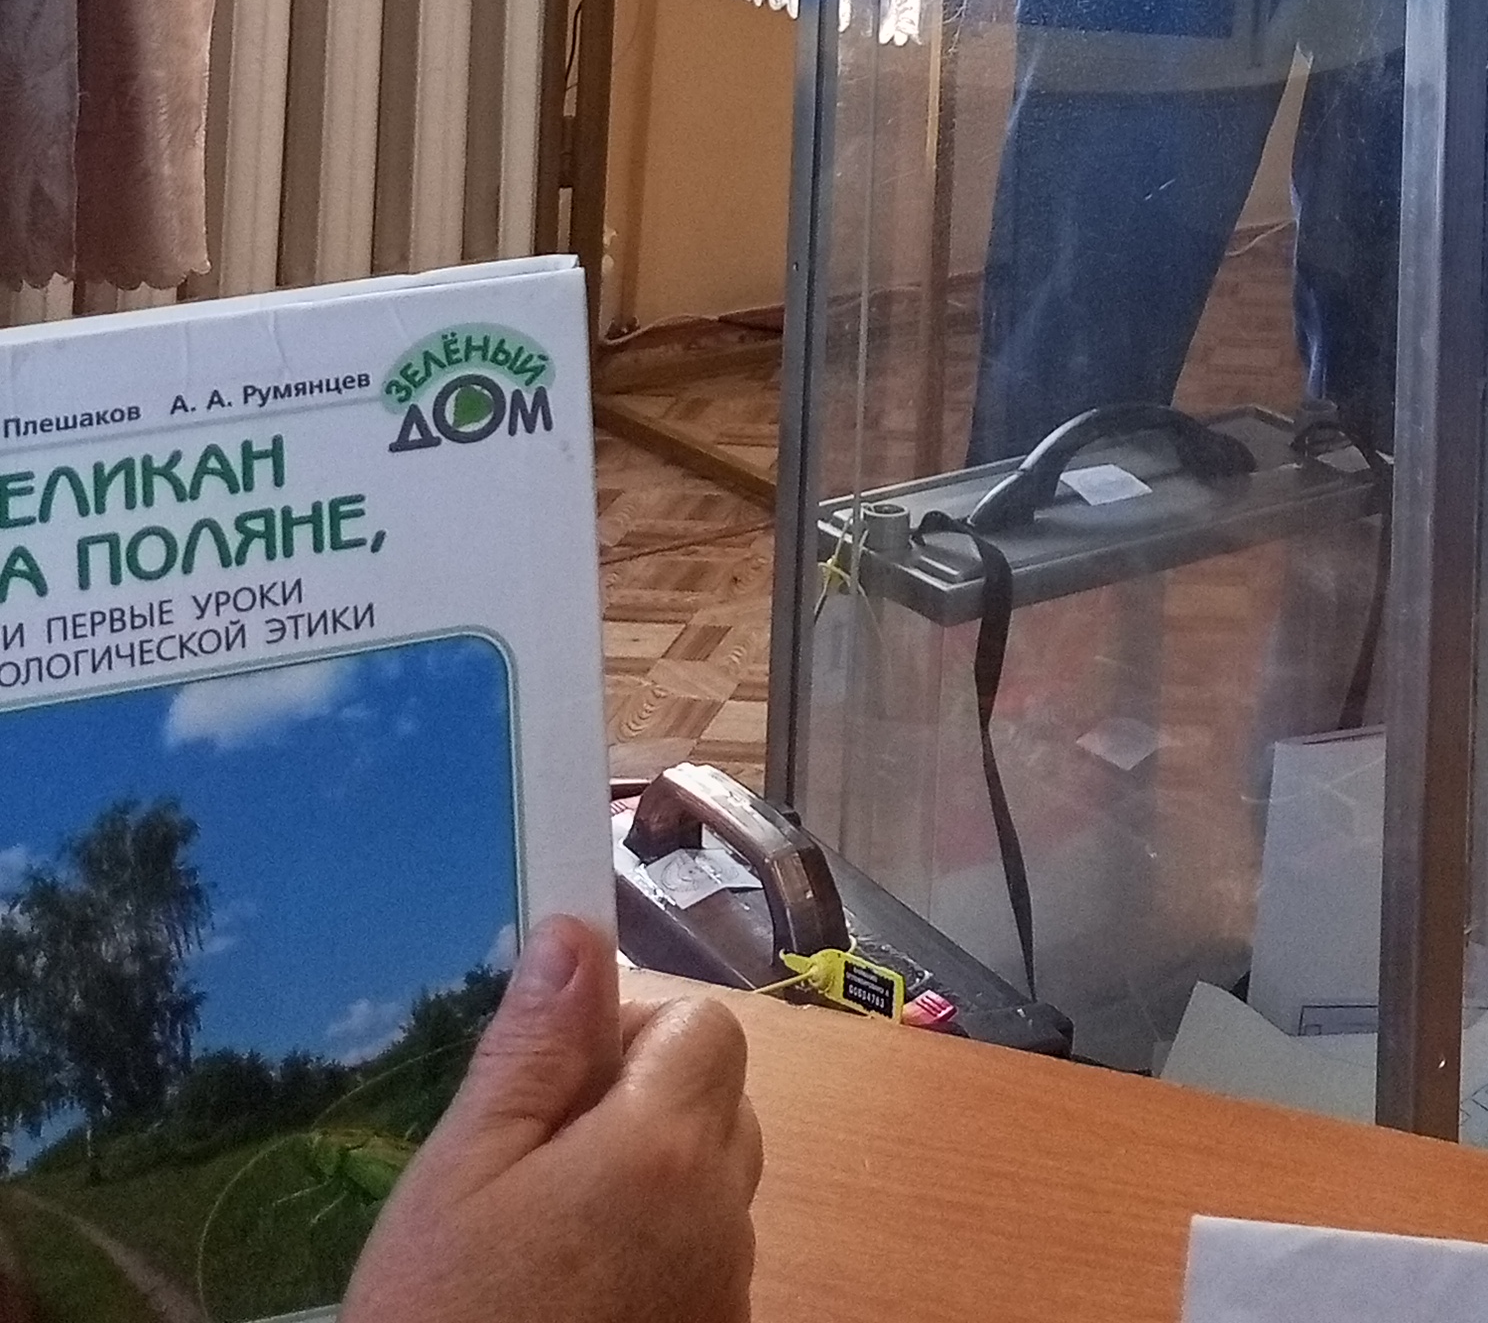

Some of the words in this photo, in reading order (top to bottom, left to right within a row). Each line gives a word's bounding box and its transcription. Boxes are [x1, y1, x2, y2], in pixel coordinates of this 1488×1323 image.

[385, 331, 550, 403] ЗЕЛЁНЫЙ
[3, 402, 142, 438] Плешаков
[169, 394, 196, 416] А.
[206, 389, 233, 411] А.
[242, 371, 371, 406] Румянцев
[388, 373, 554, 453] ДОМ
[76, 493, 387, 591] ПОЛЯНЕ,
[46, 598, 175, 645] ПЕРВЫЕ
[192, 576, 304, 622] УРОКИ
[265, 601, 377, 645] ЭТИКИ
